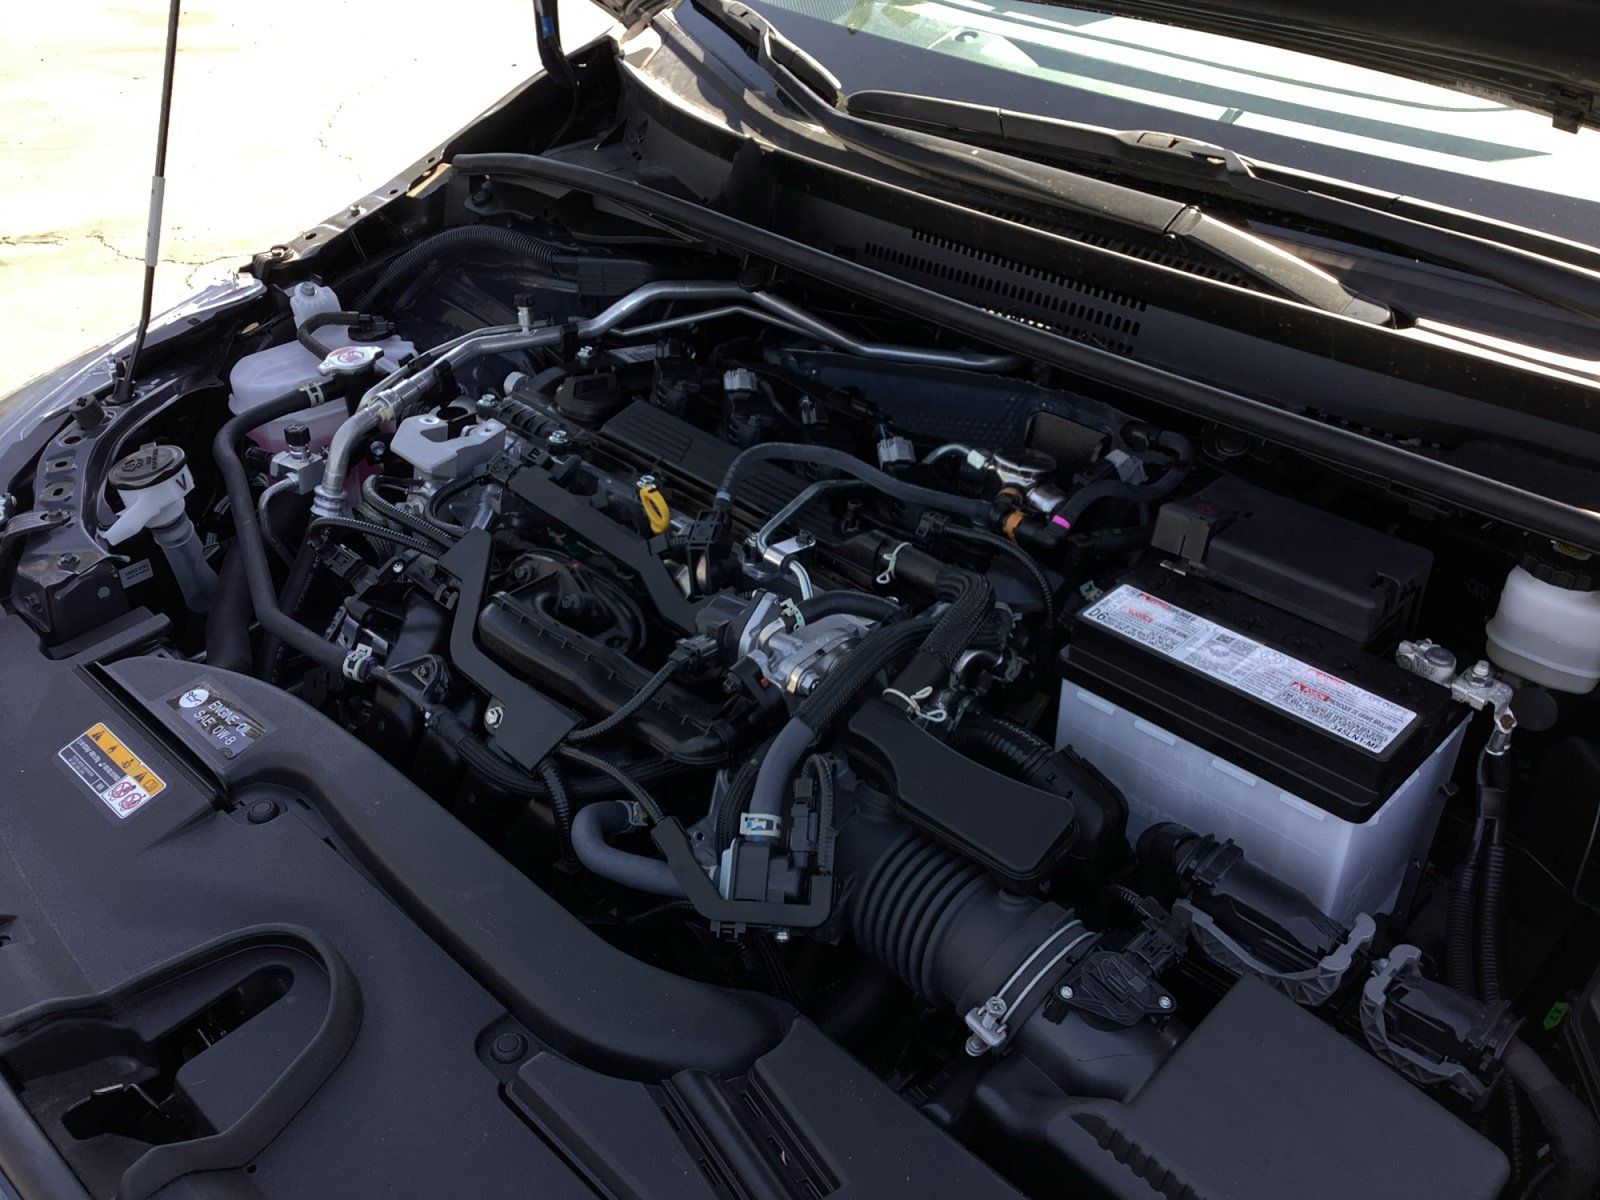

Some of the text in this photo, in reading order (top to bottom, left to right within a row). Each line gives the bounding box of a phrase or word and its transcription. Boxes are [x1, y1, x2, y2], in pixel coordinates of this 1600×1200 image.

[1088, 608, 1109, 621] D6
[193, 709, 237, 746] SAE 0W-8
[208, 700, 252, 738] ENGINE OIL
[1330, 725, 1382, 750] 345LN1-MF
